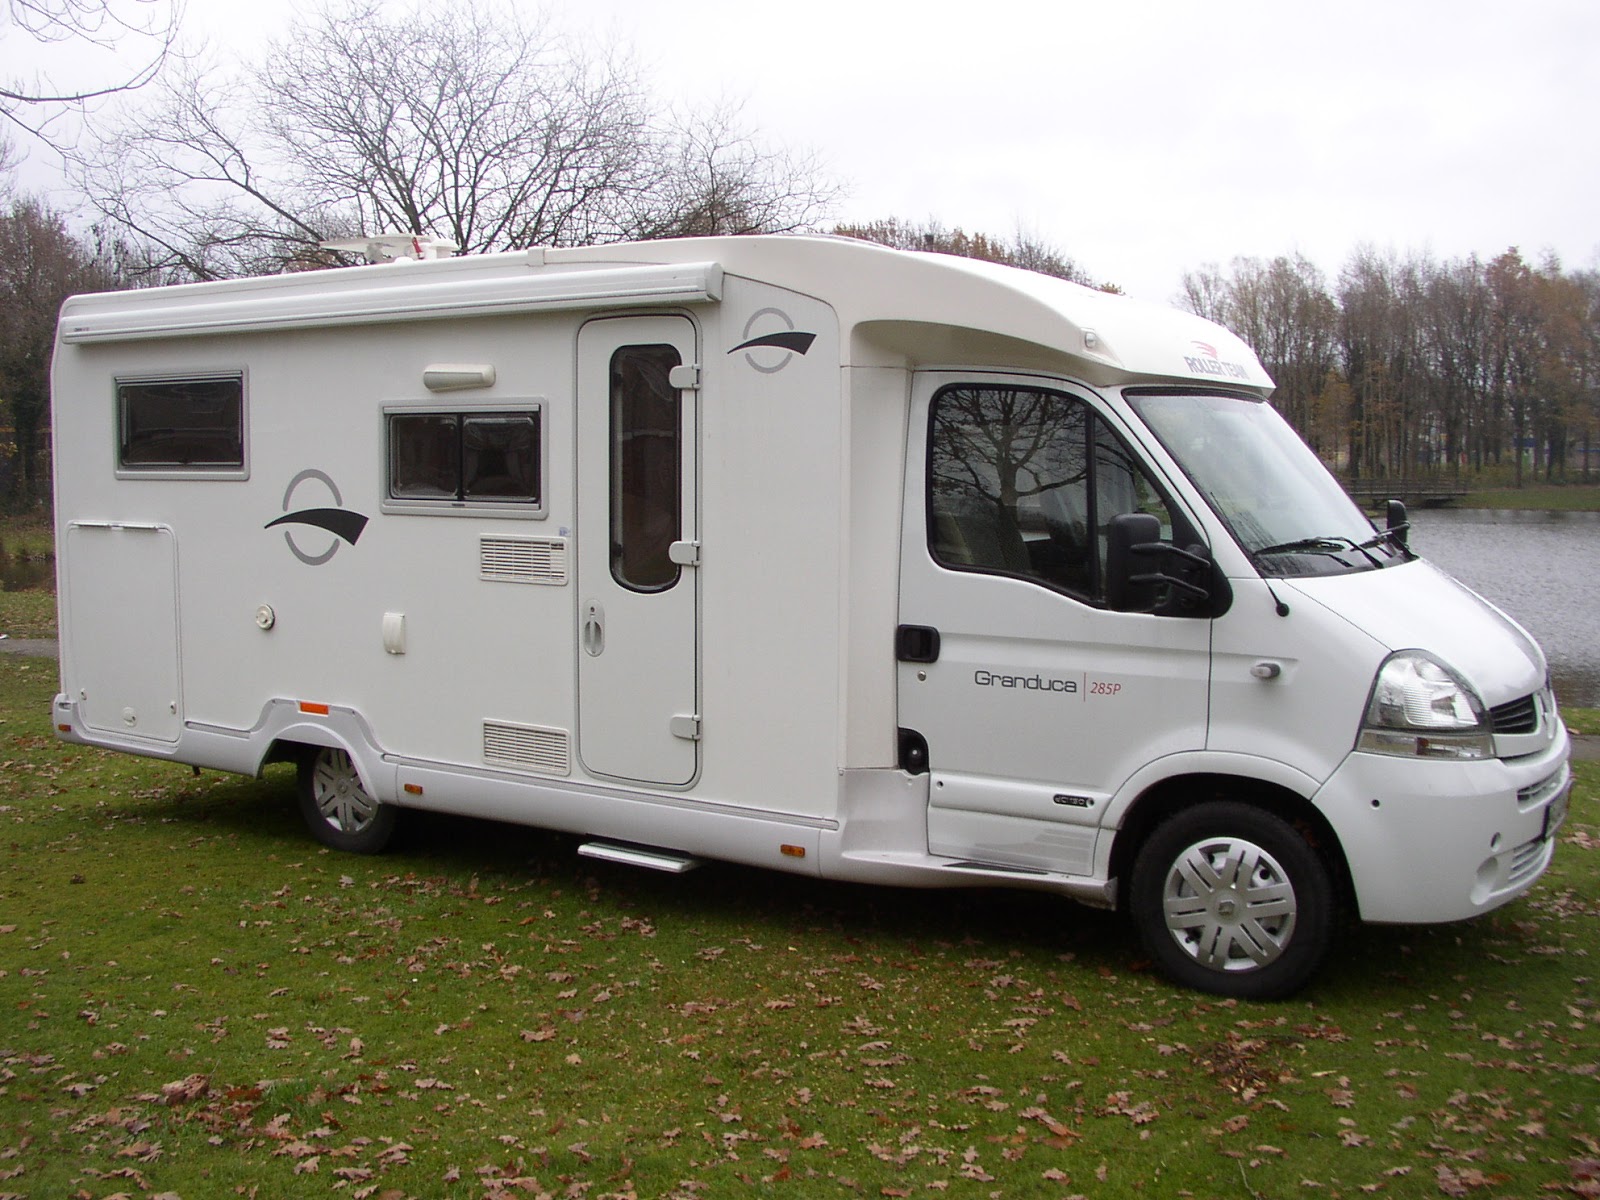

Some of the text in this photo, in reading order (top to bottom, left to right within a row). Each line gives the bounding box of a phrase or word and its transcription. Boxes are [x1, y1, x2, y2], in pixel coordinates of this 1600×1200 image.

[1184, 356, 1226, 375] ROLLER
[974, 670, 1122, 695] Granduca 285P
